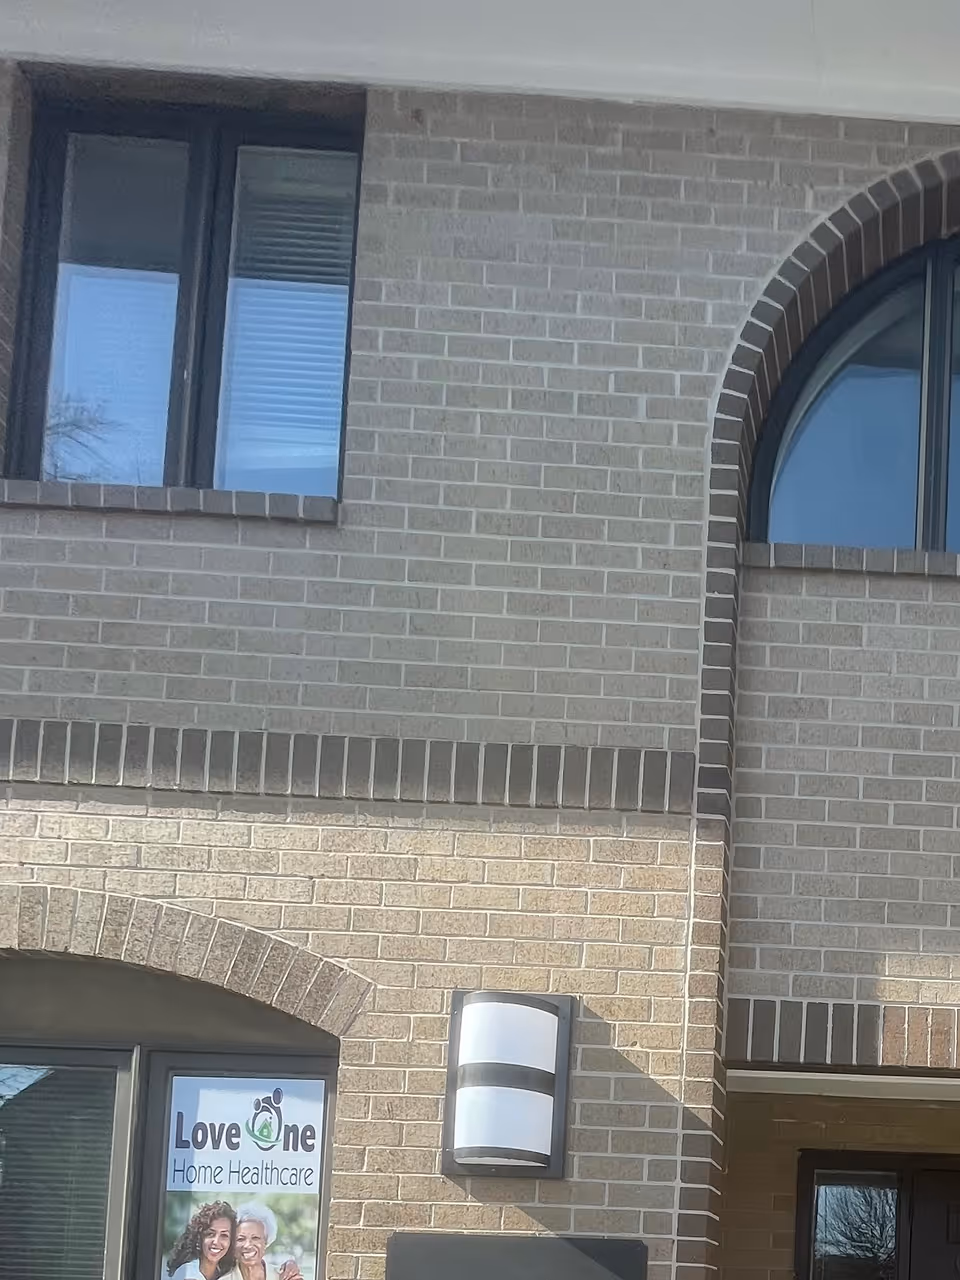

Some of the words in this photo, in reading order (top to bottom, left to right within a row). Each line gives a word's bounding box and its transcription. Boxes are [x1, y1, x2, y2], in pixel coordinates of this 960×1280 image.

[175, 1111, 241, 1151] Love
[172, 1158, 224, 1184] Home
[228, 1159, 314, 1186] Healthcare
